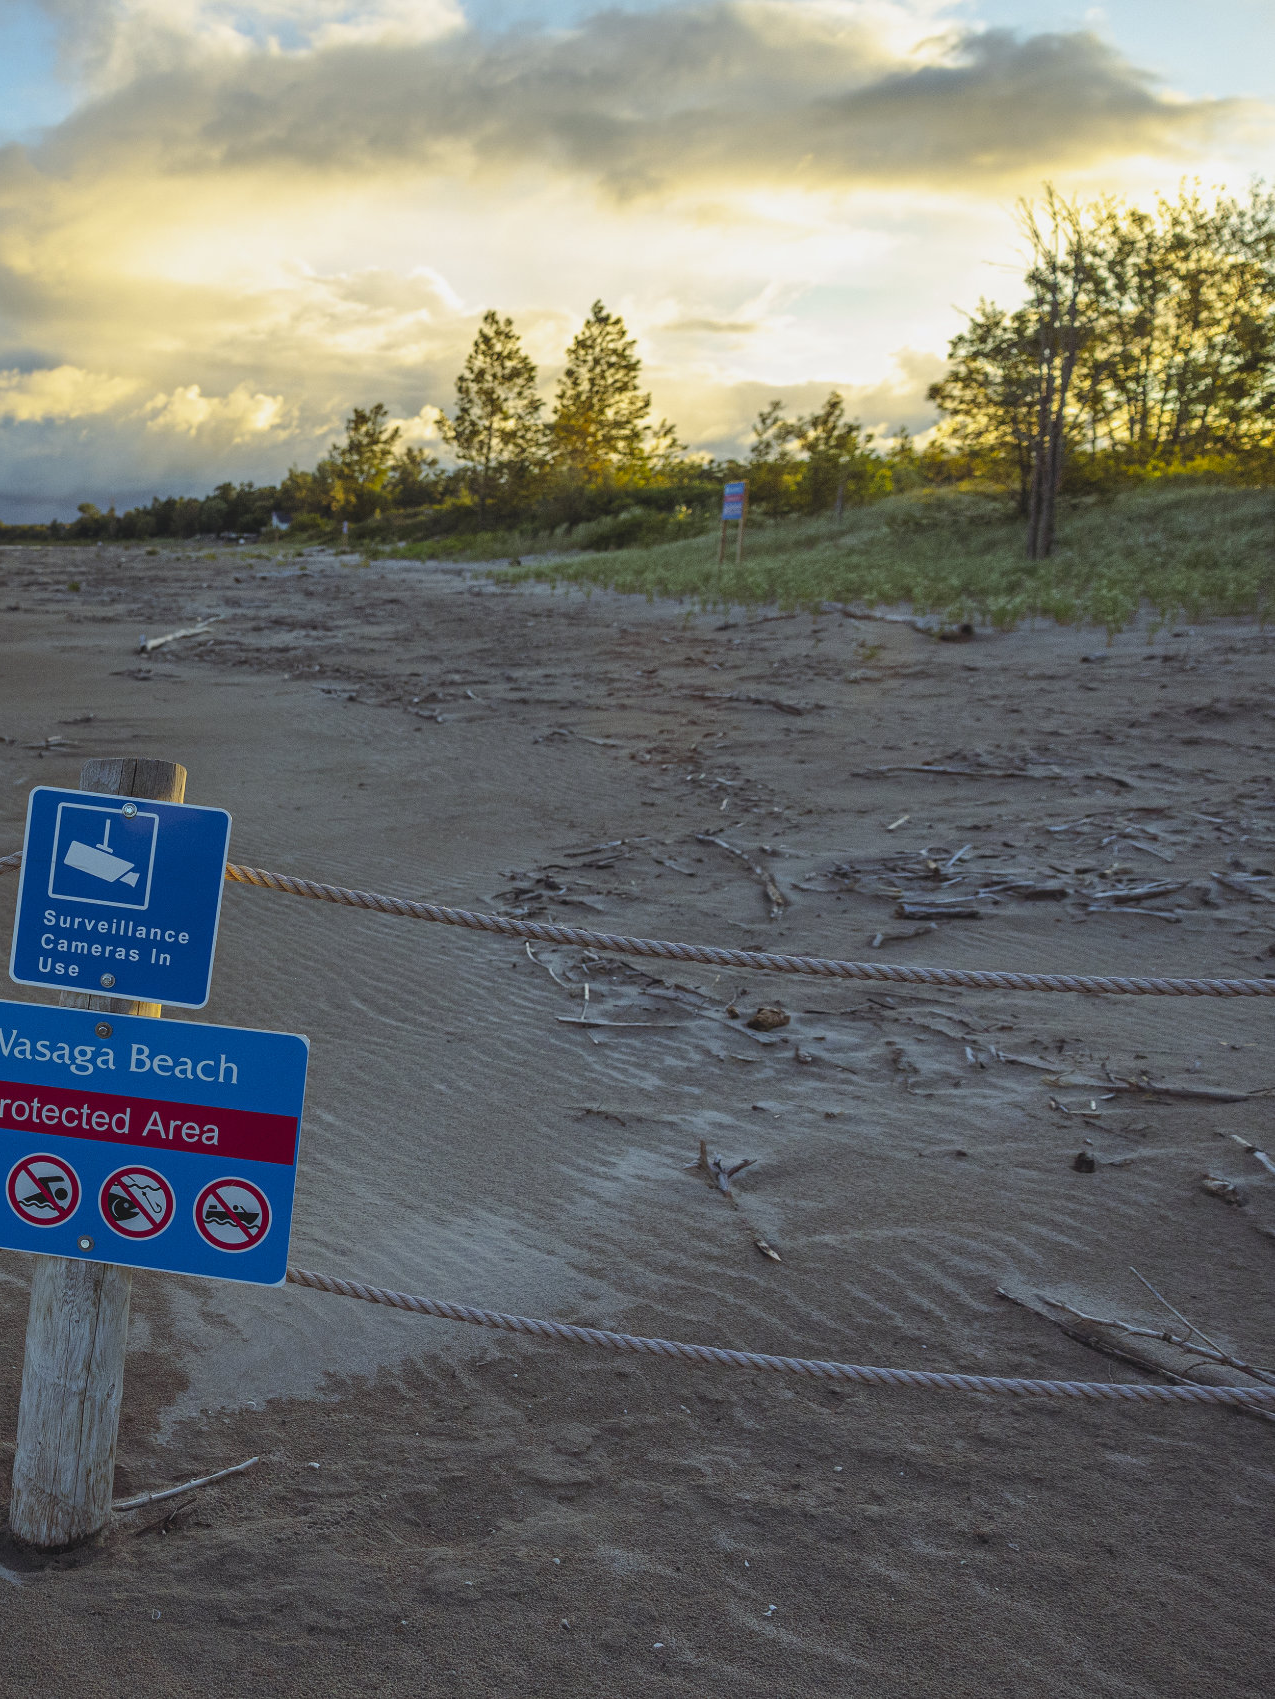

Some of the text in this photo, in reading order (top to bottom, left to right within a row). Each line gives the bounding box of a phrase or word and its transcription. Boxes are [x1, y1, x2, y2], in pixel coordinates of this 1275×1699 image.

[43, 909, 190, 944] Surveillance
[38, 956, 79, 977] Use
[40, 933, 171, 966] Cameras In
[129, 1044, 239, 1085] Beach
[142, 1111, 220, 1146] Area
